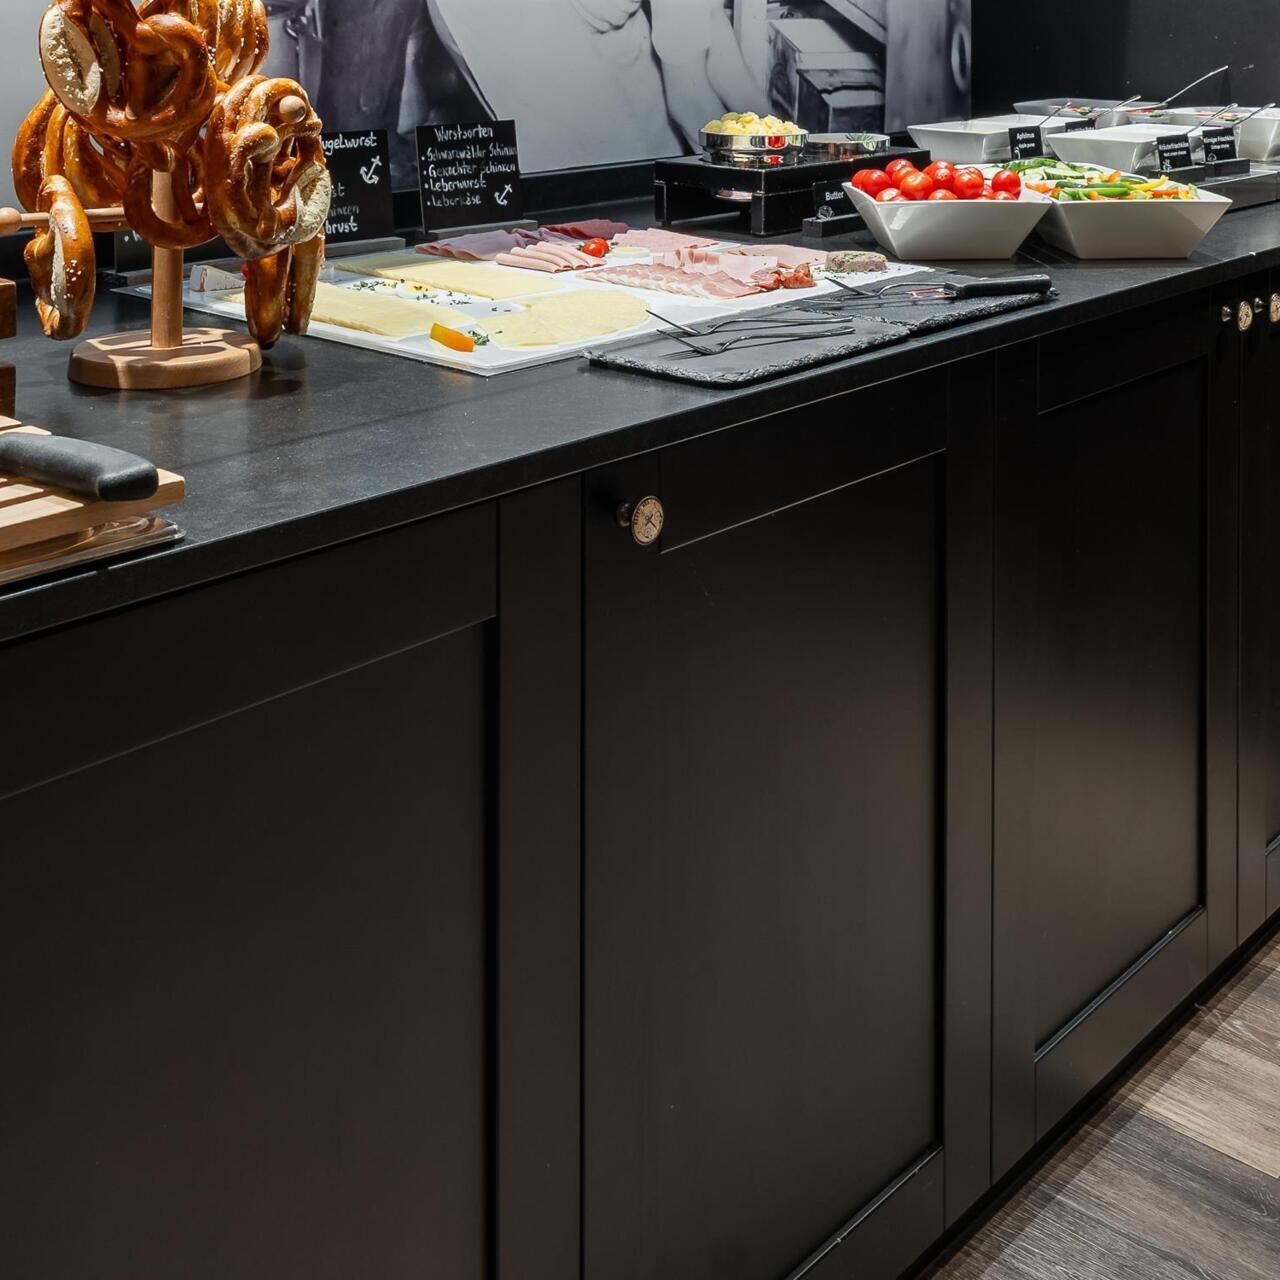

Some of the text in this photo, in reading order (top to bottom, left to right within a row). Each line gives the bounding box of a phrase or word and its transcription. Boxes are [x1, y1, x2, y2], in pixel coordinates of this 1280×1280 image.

[434, 124, 494, 142] Wurstsorten
[321, 131, 377, 156] ugelwurst
[430, 173, 486, 191] Leberwurst
[825, 191, 844, 200] Butter
[325, 215, 358, 234] brust
